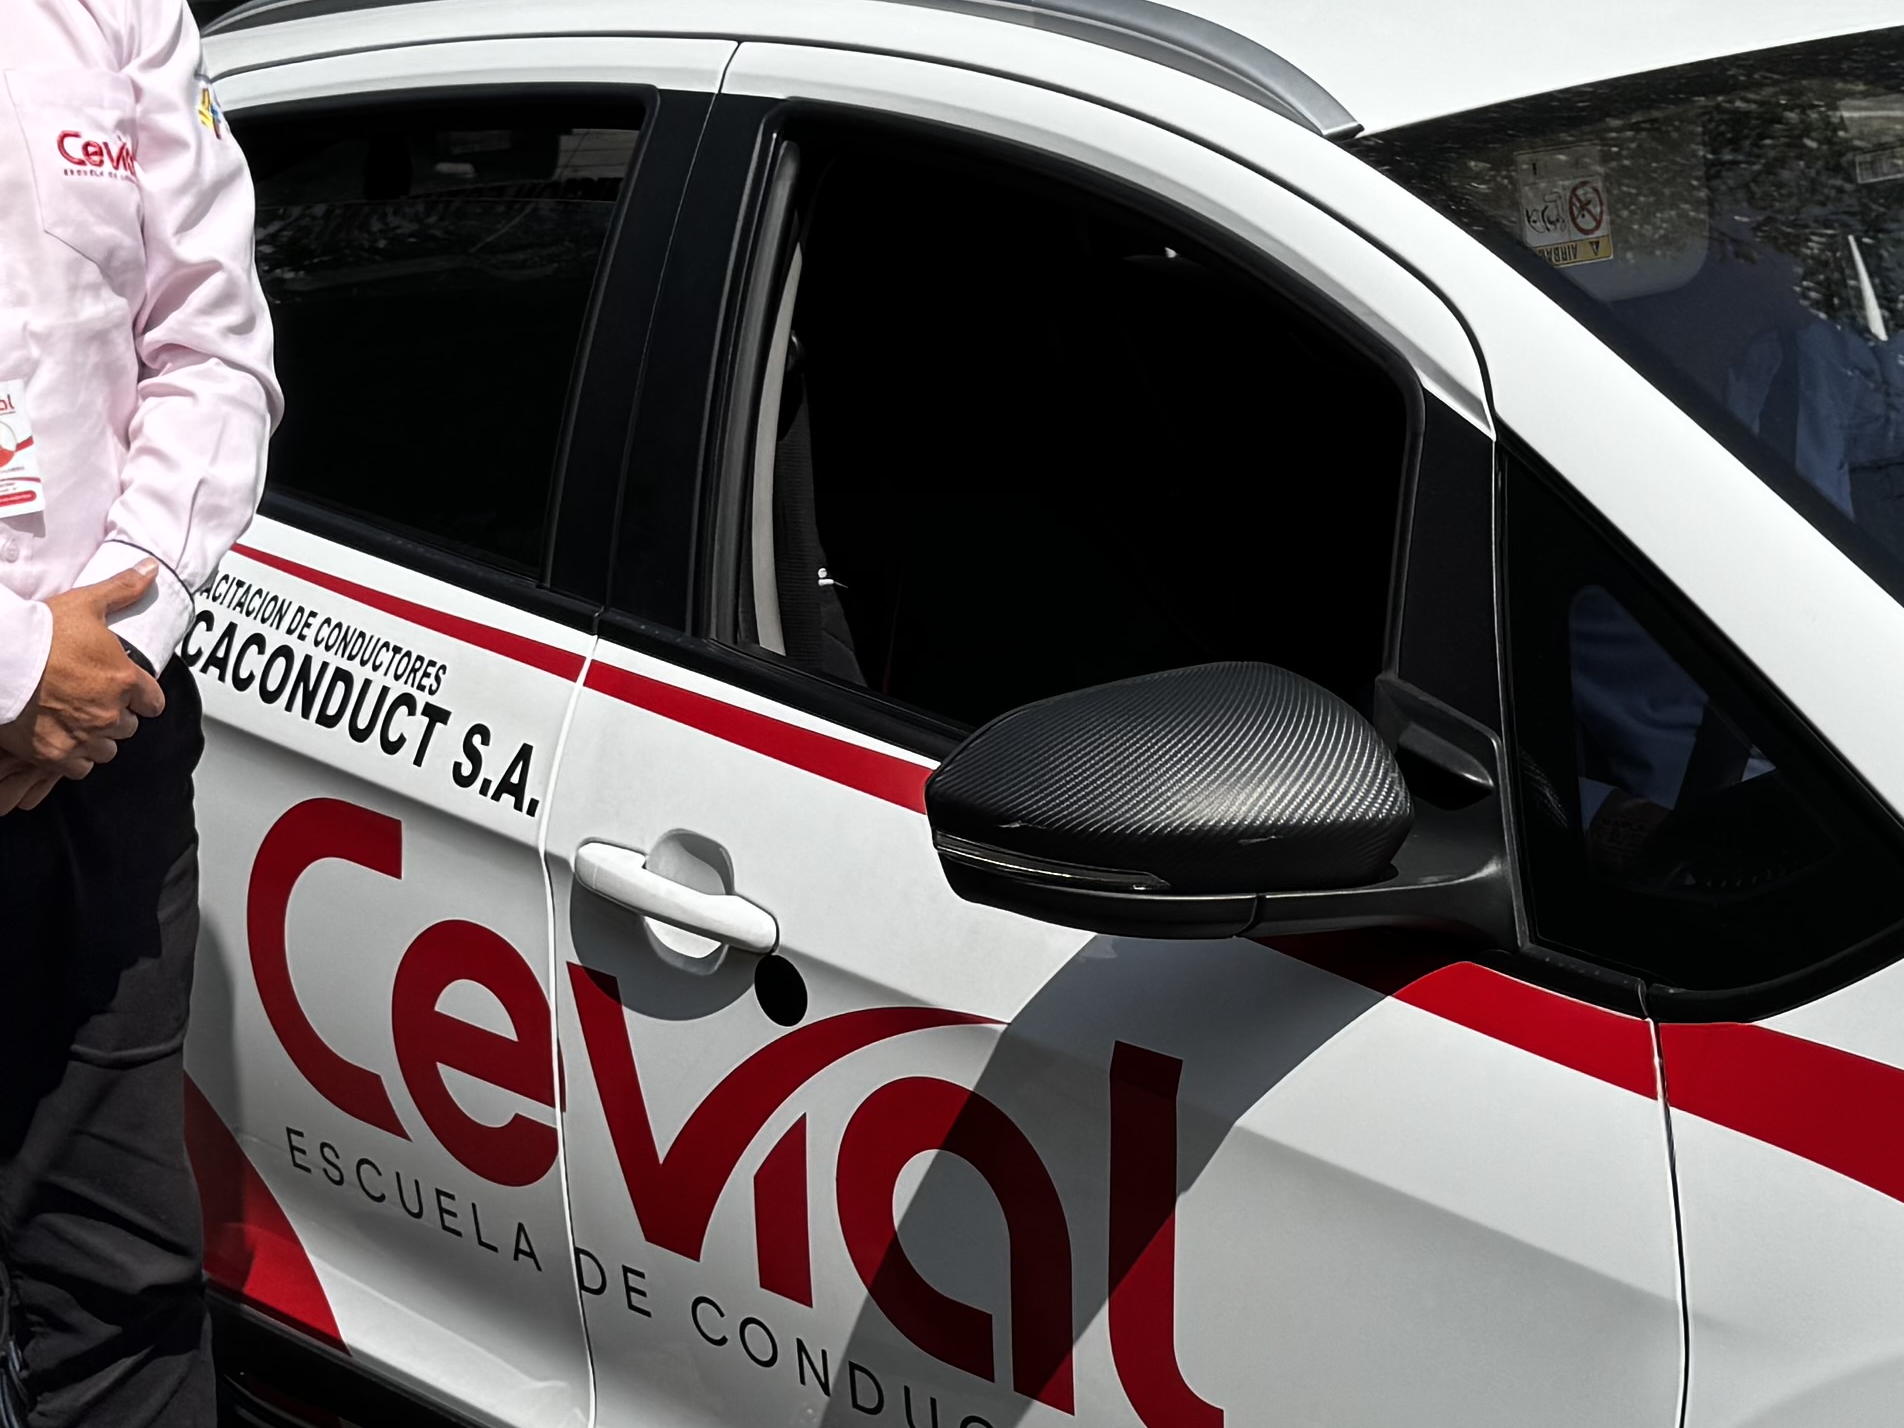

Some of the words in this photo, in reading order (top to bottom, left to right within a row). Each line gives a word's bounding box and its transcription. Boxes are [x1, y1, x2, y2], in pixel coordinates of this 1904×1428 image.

[181, 609, 452, 768] CACONDUCT
[452, 723, 540, 817] S.A.
[286, 605, 318, 642] DE
[313, 616, 448, 696] CONDUCTORES
[286, 1127, 542, 1272] ESCUELA
[575, 1246, 654, 1319] DE
